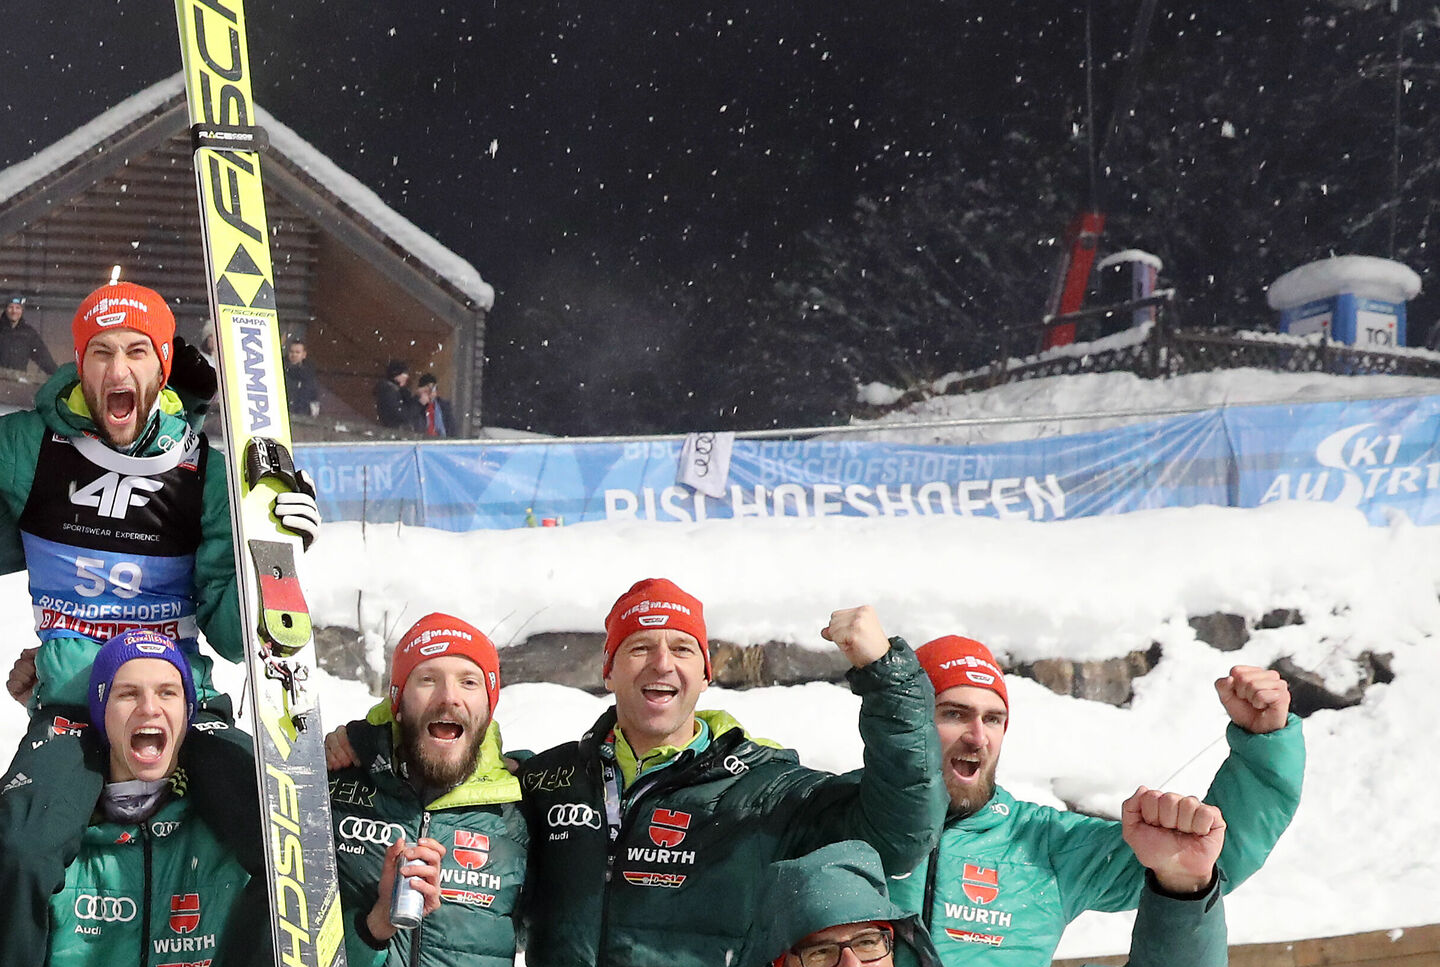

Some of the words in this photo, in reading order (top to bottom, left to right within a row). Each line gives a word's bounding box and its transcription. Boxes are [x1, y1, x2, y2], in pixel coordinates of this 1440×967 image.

[83, 298, 148, 321] VIESSMANN
[221, 309, 276, 317] FISCHER
[232, 317, 266, 327] KAMPA
[240, 326, 271, 432] KAMPA
[71, 472, 164, 519] 4F
[63, 522, 111, 536] SPORTSWEAR
[115, 531, 160, 542] EXPERIENCE
[74, 556, 143, 599] 59
[621, 600, 691, 619] VIESSMANN
[403, 630, 472, 652] VIESSMANN
[549, 831, 569, 841] Audi
[338, 843, 365, 855] Audi
[627, 847, 695, 865] WÜRTH
[945, 903, 1012, 928] WÜRTH
[75, 924, 102, 935] Audi
[153, 934, 216, 954] WÜRTH
